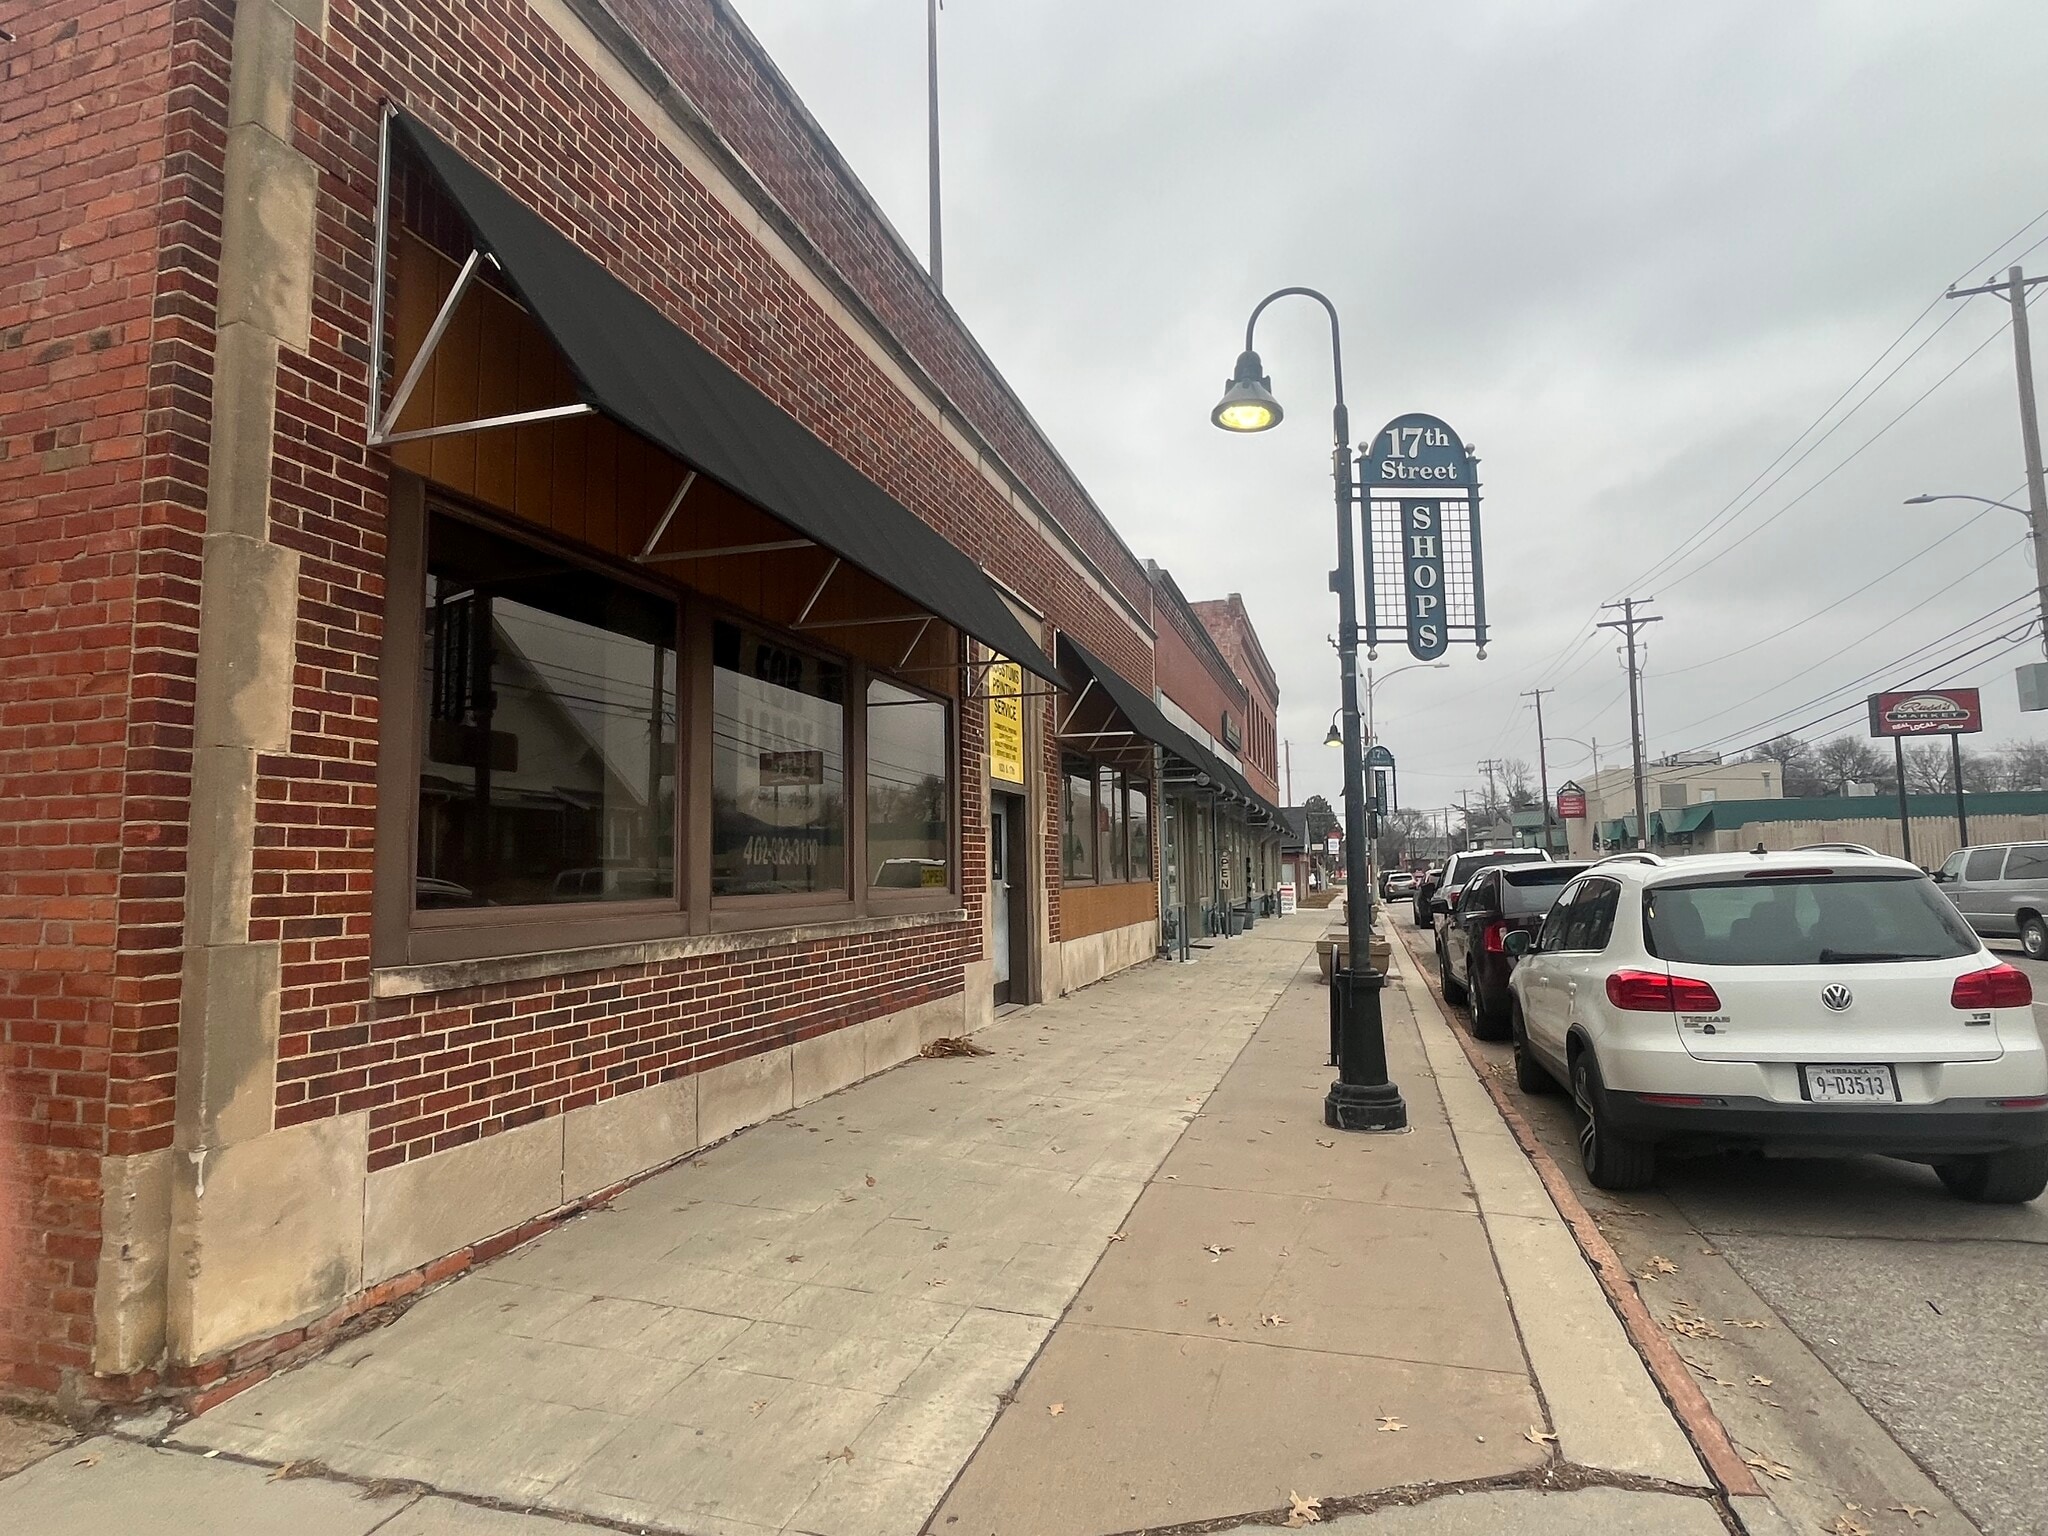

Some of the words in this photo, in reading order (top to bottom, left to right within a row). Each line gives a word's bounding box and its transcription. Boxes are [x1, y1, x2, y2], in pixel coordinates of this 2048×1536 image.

[1386, 427, 1450, 459] 17th
[1381, 460, 1457, 480] Street
[1411, 506, 1439, 648] SHOPS
[994, 697, 1018, 721] SERVICE
[1898, 701, 1951, 712] Russ's
[1891, 722, 1910, 730] REAL
[1909, 721, 1937, 731] LOCAL
[1221, 850, 1230, 889] OPEN
[1825, 1067, 1870, 1075] NEBRASKA
[1816, 1076, 1885, 1096] 9-D3513
